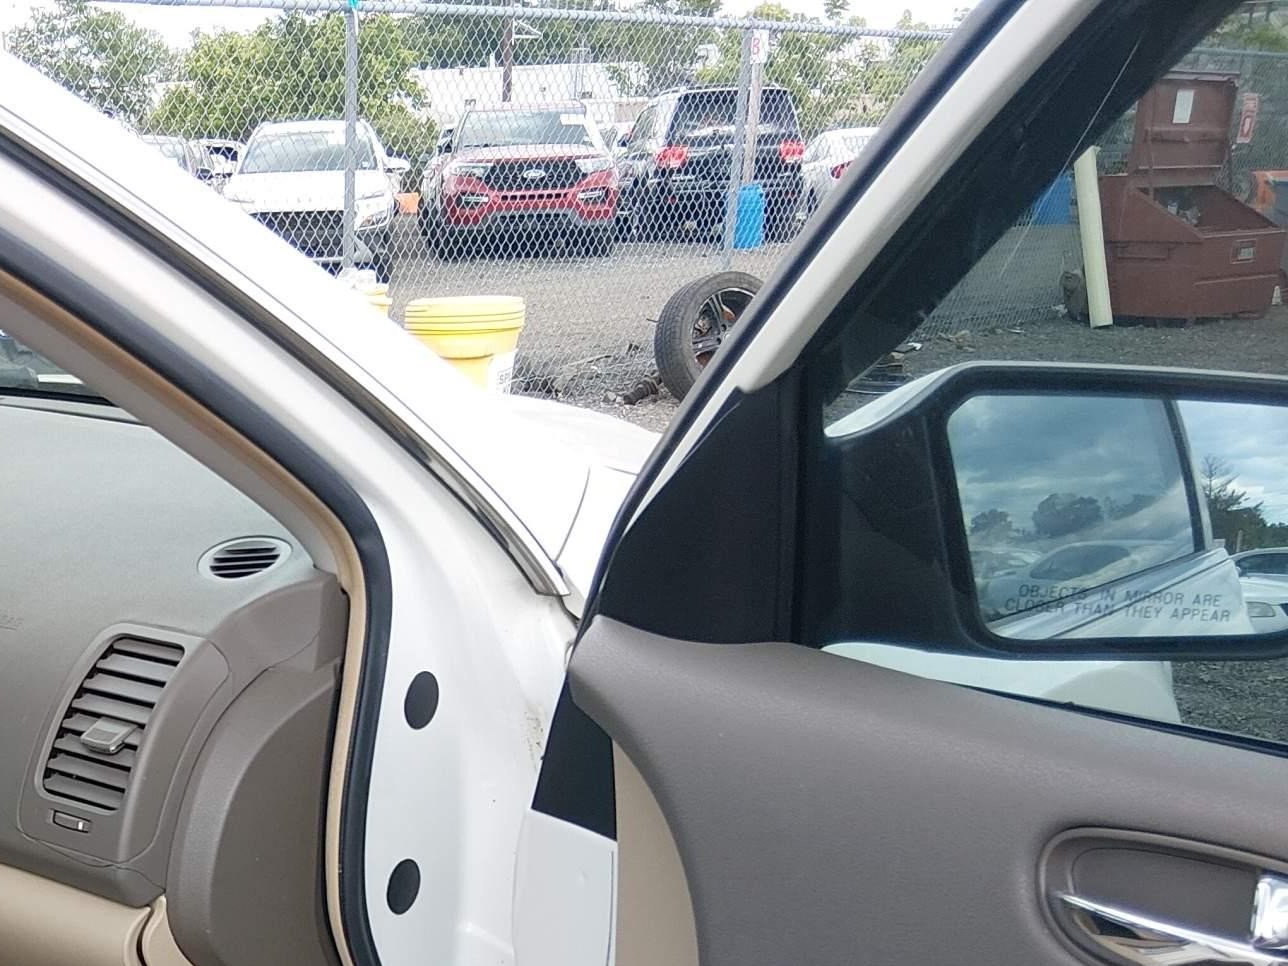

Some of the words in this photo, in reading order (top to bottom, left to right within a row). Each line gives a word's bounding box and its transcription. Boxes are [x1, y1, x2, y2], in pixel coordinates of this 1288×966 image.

[1018, 584, 1088, 599] OBJECTS
[1099, 588, 1116, 601] IN
[1124, 589, 1185, 605] MIRROR
[1192, 593, 1223, 607] ARE
[1004, 598, 1065, 614] CLOSER
[1074, 602, 1111, 616] THAN
[1124, 605, 1162, 619] THEY
[1170, 607, 1231, 622] APPEAR
